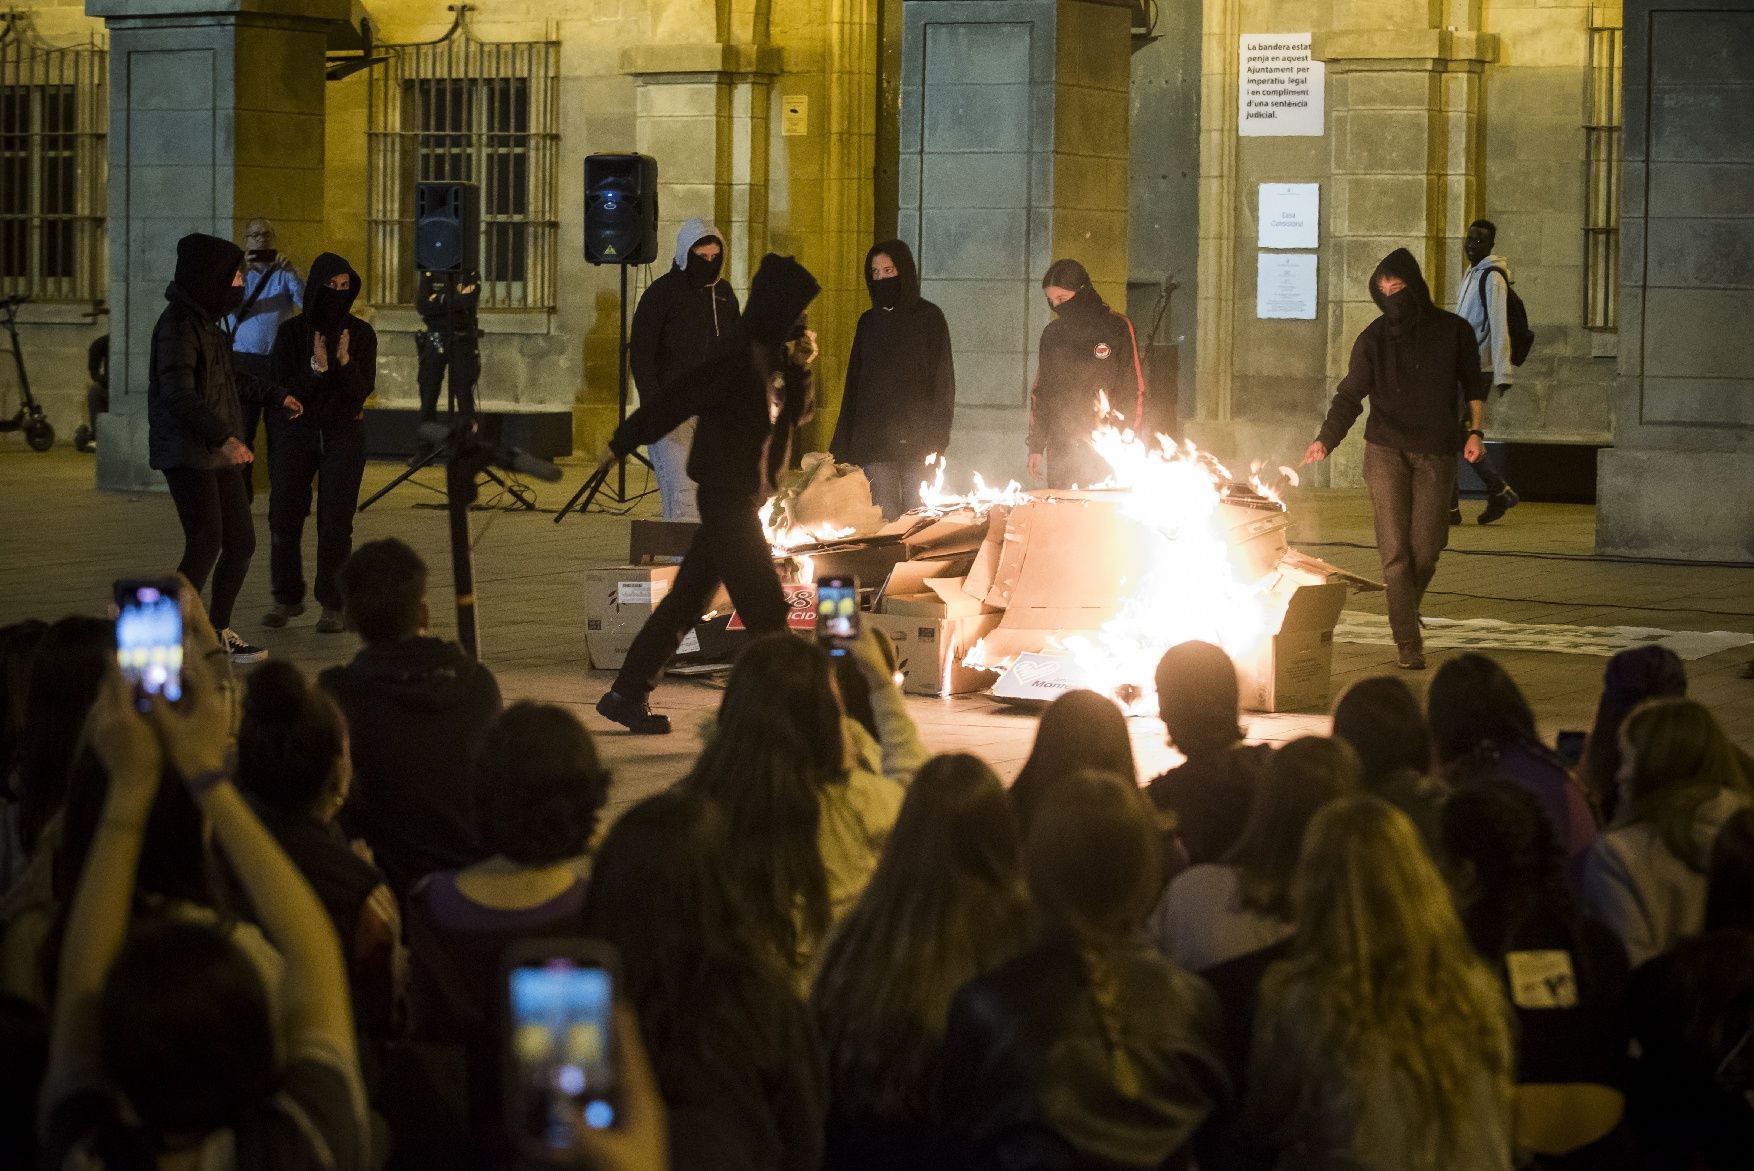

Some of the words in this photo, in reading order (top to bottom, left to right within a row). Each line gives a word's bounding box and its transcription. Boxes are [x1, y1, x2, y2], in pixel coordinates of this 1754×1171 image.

[1258, 43, 1290, 51] bandera
[1247, 54, 1270, 63] penja
[1281, 54, 1308, 63] aquest
[1247, 66, 1294, 75] Ajuntament
[1296, 67, 1310, 75] per
[1247, 77, 1285, 86] imperatiu
[1288, 77, 1307, 86] legal
[1261, 88, 1309, 97] compliment
[1270, 99, 1308, 107] sentència
[1246, 111, 1278, 120] judicial.
